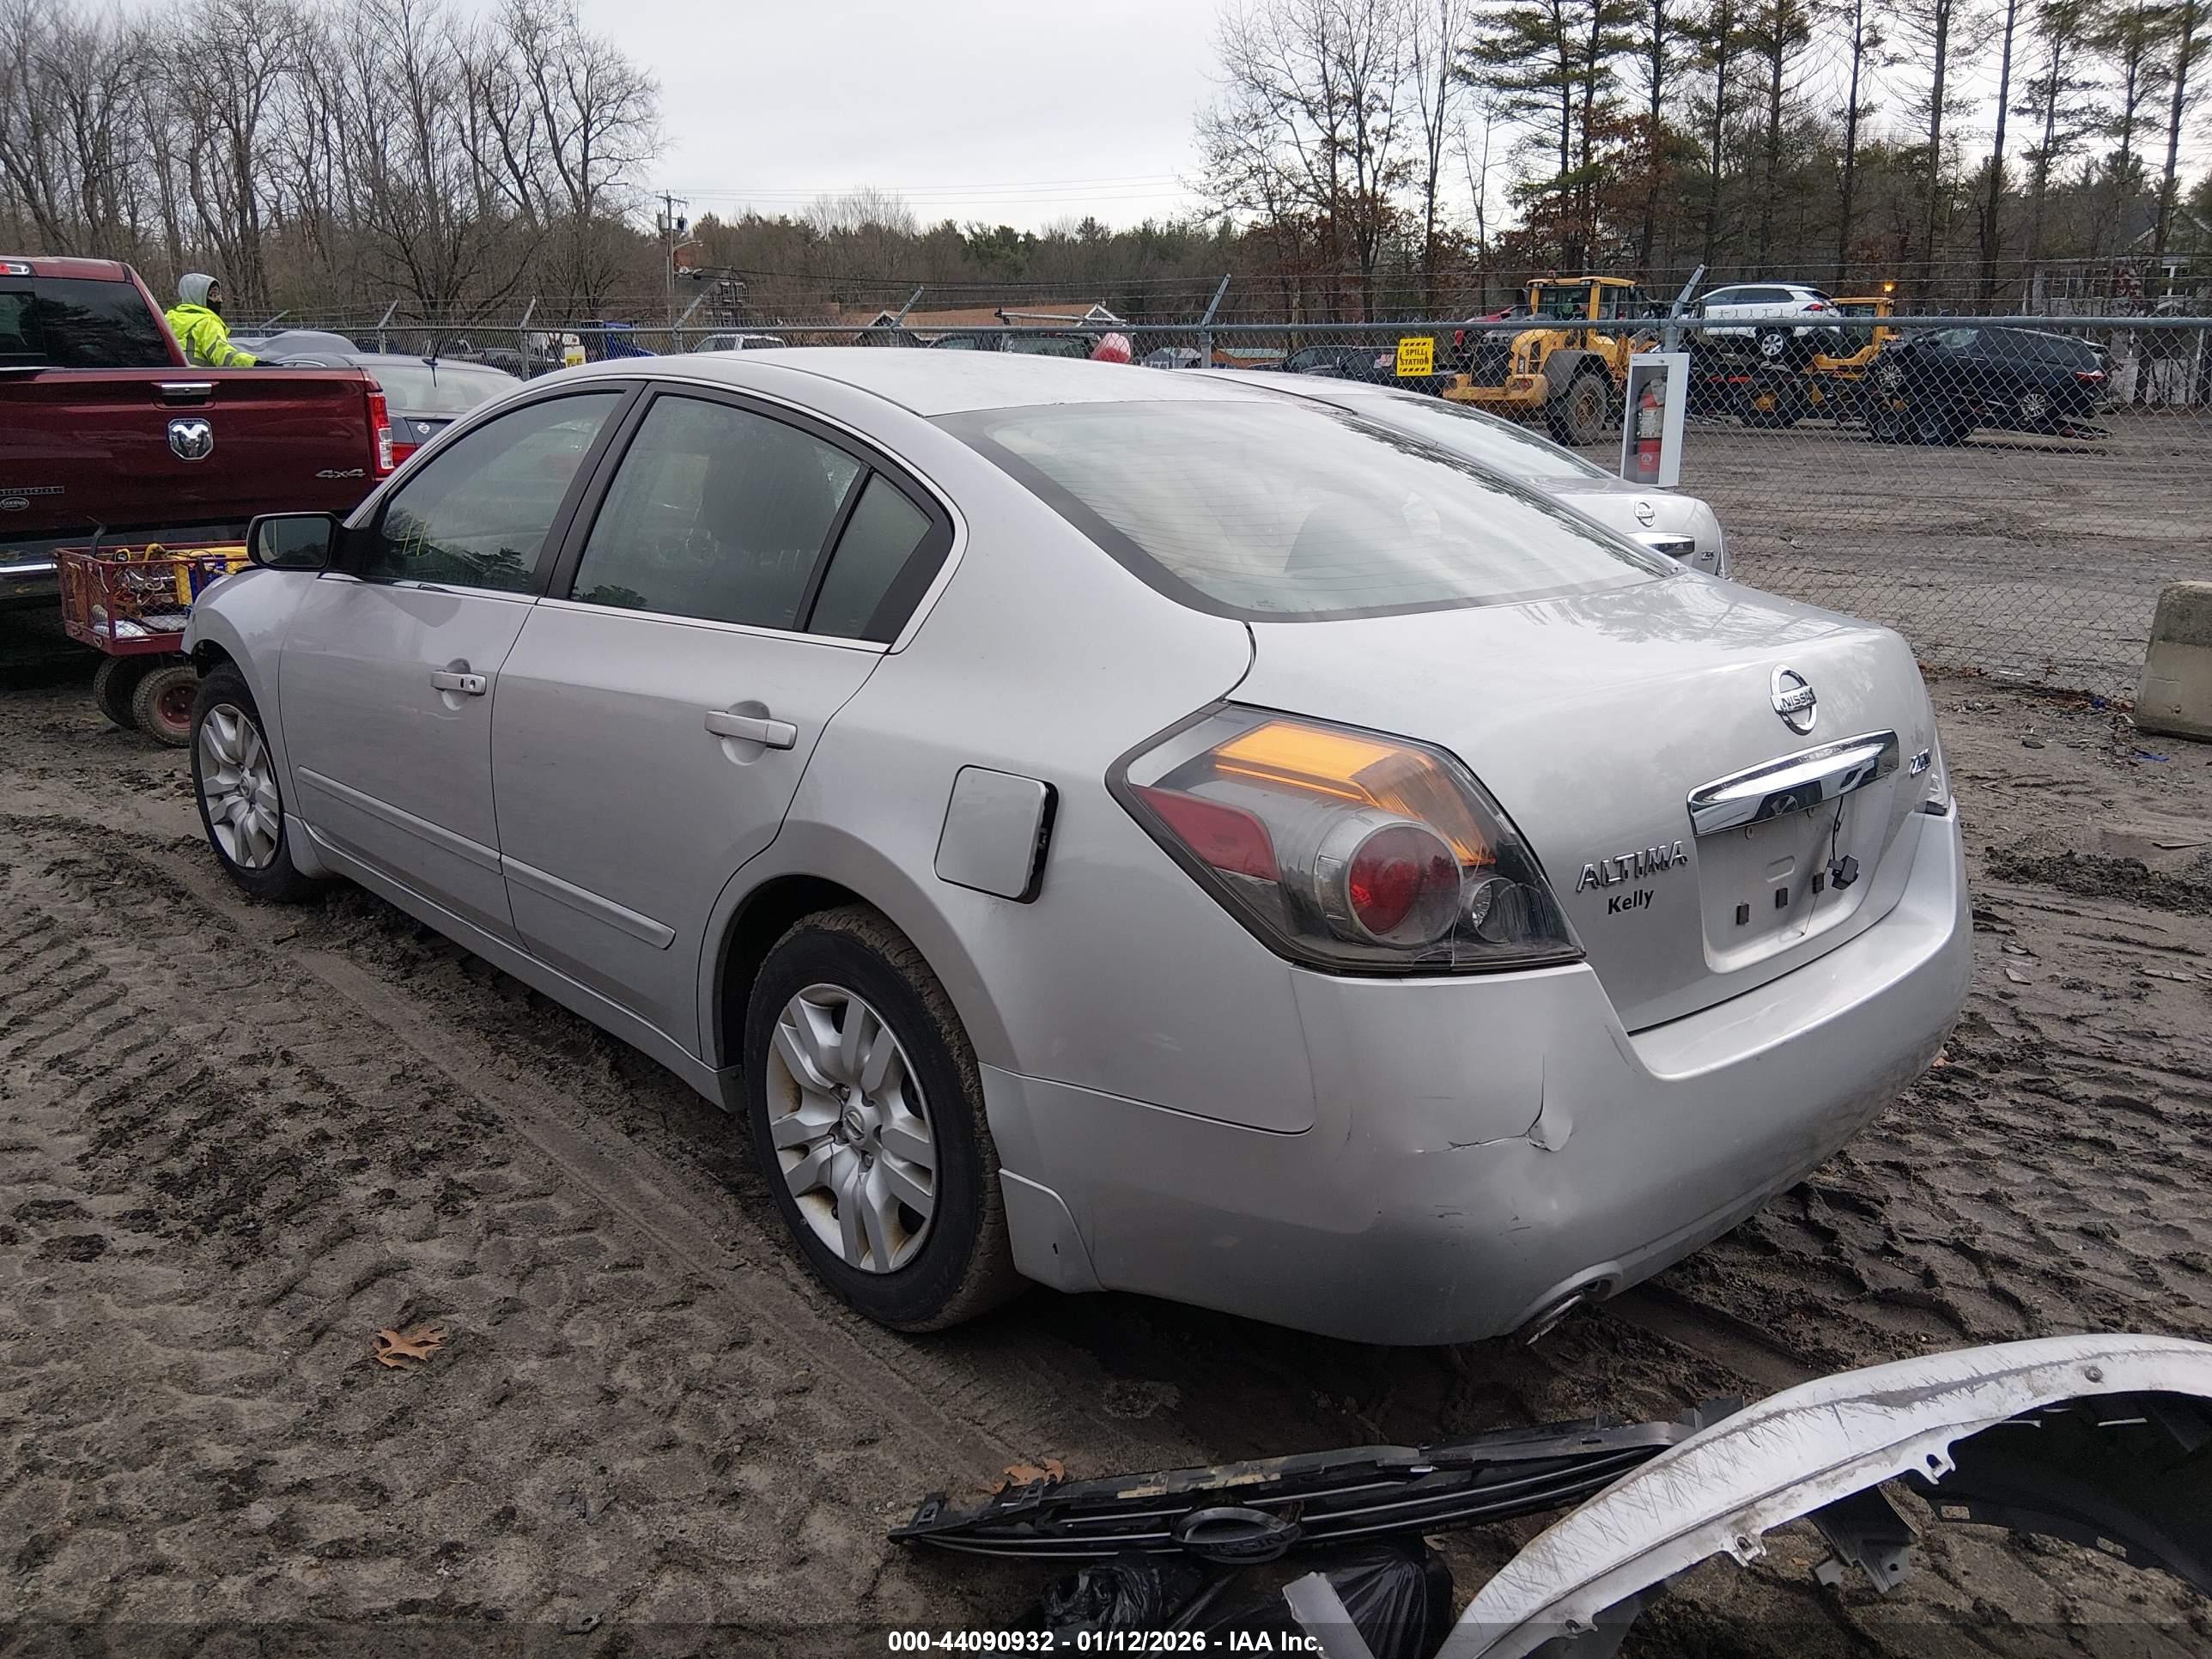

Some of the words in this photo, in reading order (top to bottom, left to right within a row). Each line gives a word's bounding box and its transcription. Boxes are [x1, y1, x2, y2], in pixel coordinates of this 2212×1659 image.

[315, 468, 366, 479] 4x4
[1780, 688, 1816, 709] NISSAN
[1575, 840, 1688, 893] ALTIMA
[1607, 889, 1655, 915] Kelly
